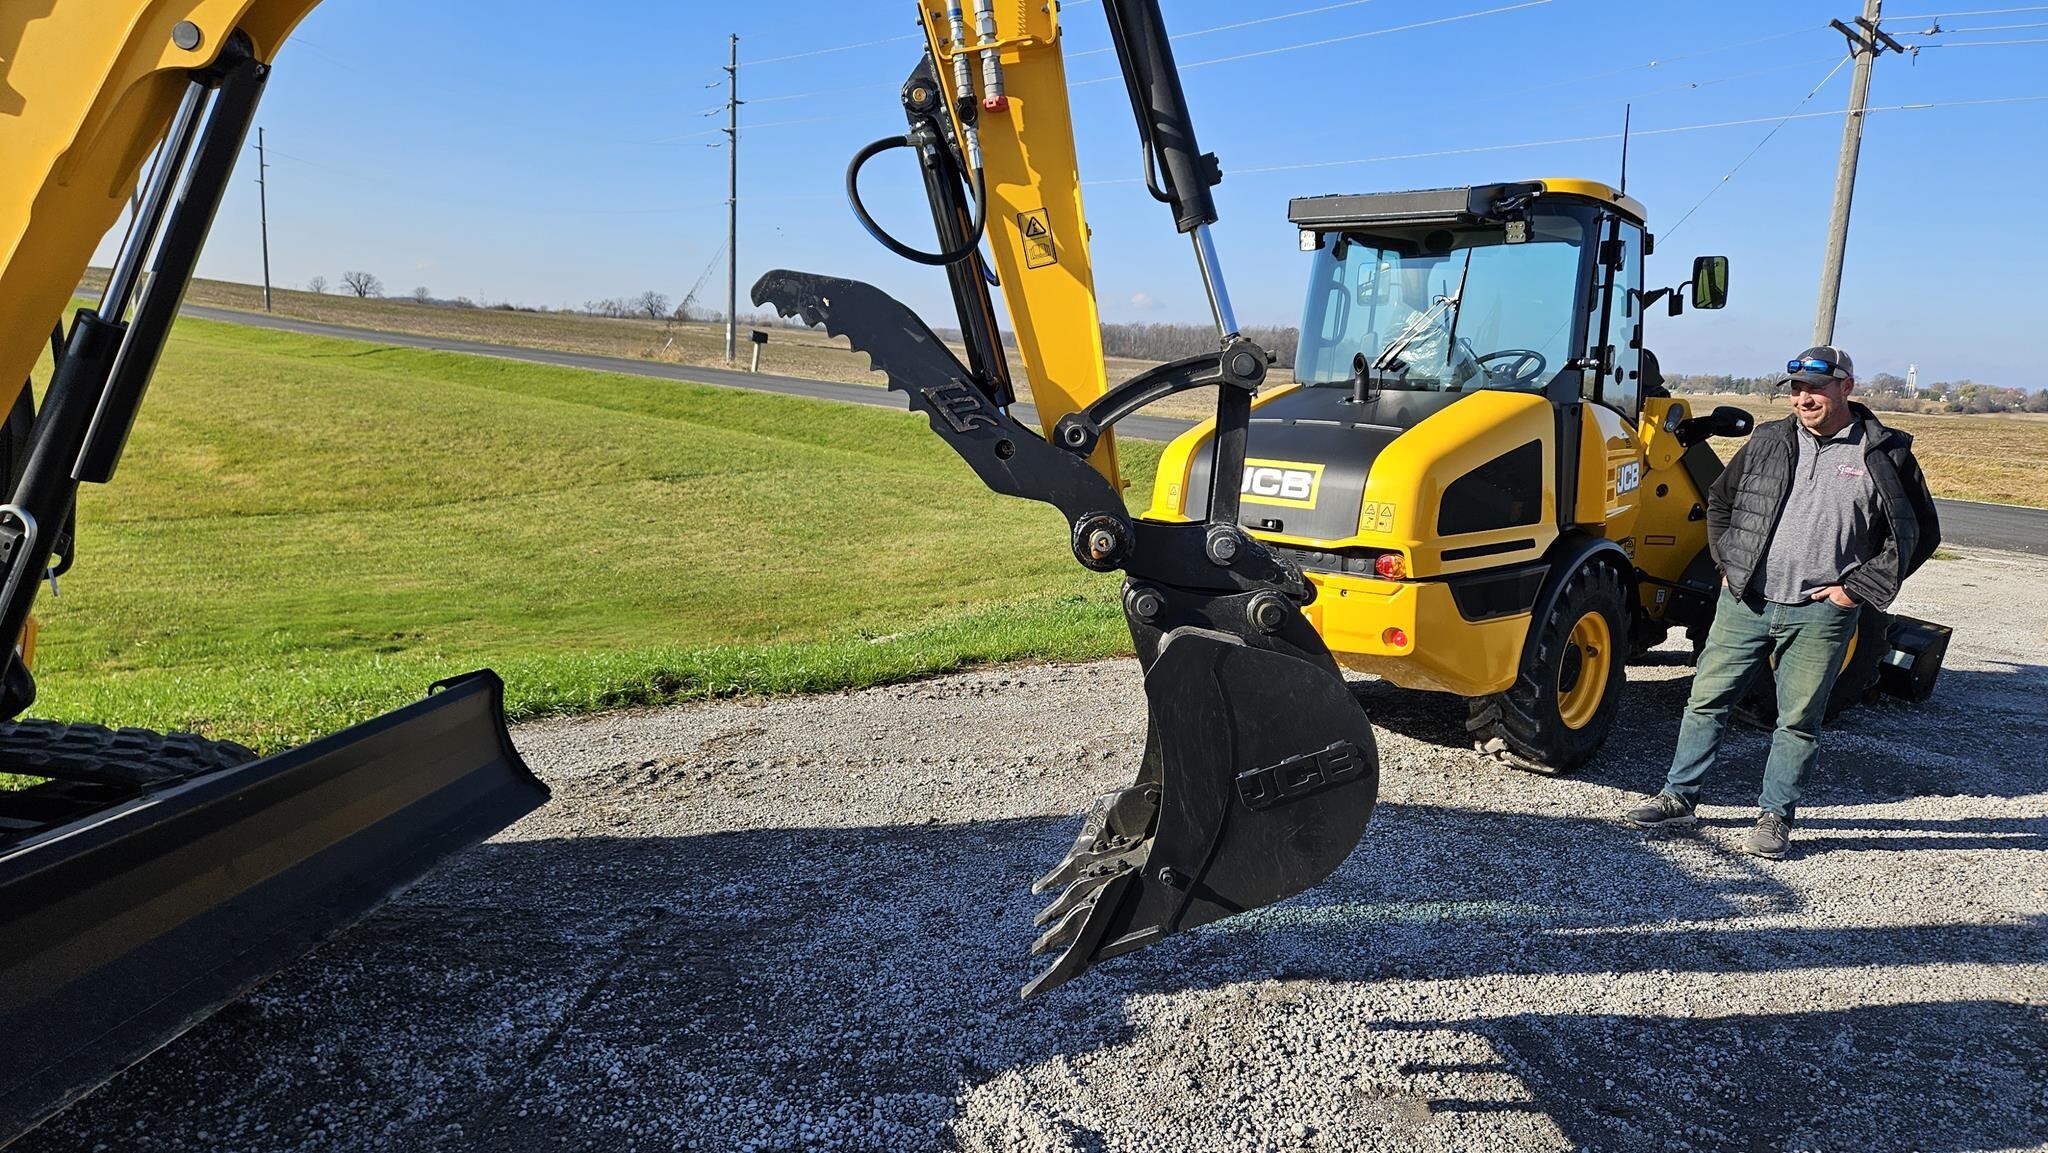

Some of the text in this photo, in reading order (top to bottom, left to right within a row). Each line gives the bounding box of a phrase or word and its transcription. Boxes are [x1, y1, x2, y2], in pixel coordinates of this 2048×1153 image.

[1240, 466, 1312, 499] JCB
[1616, 461, 1639, 494] JCB
[1235, 740, 1373, 811] JCB
